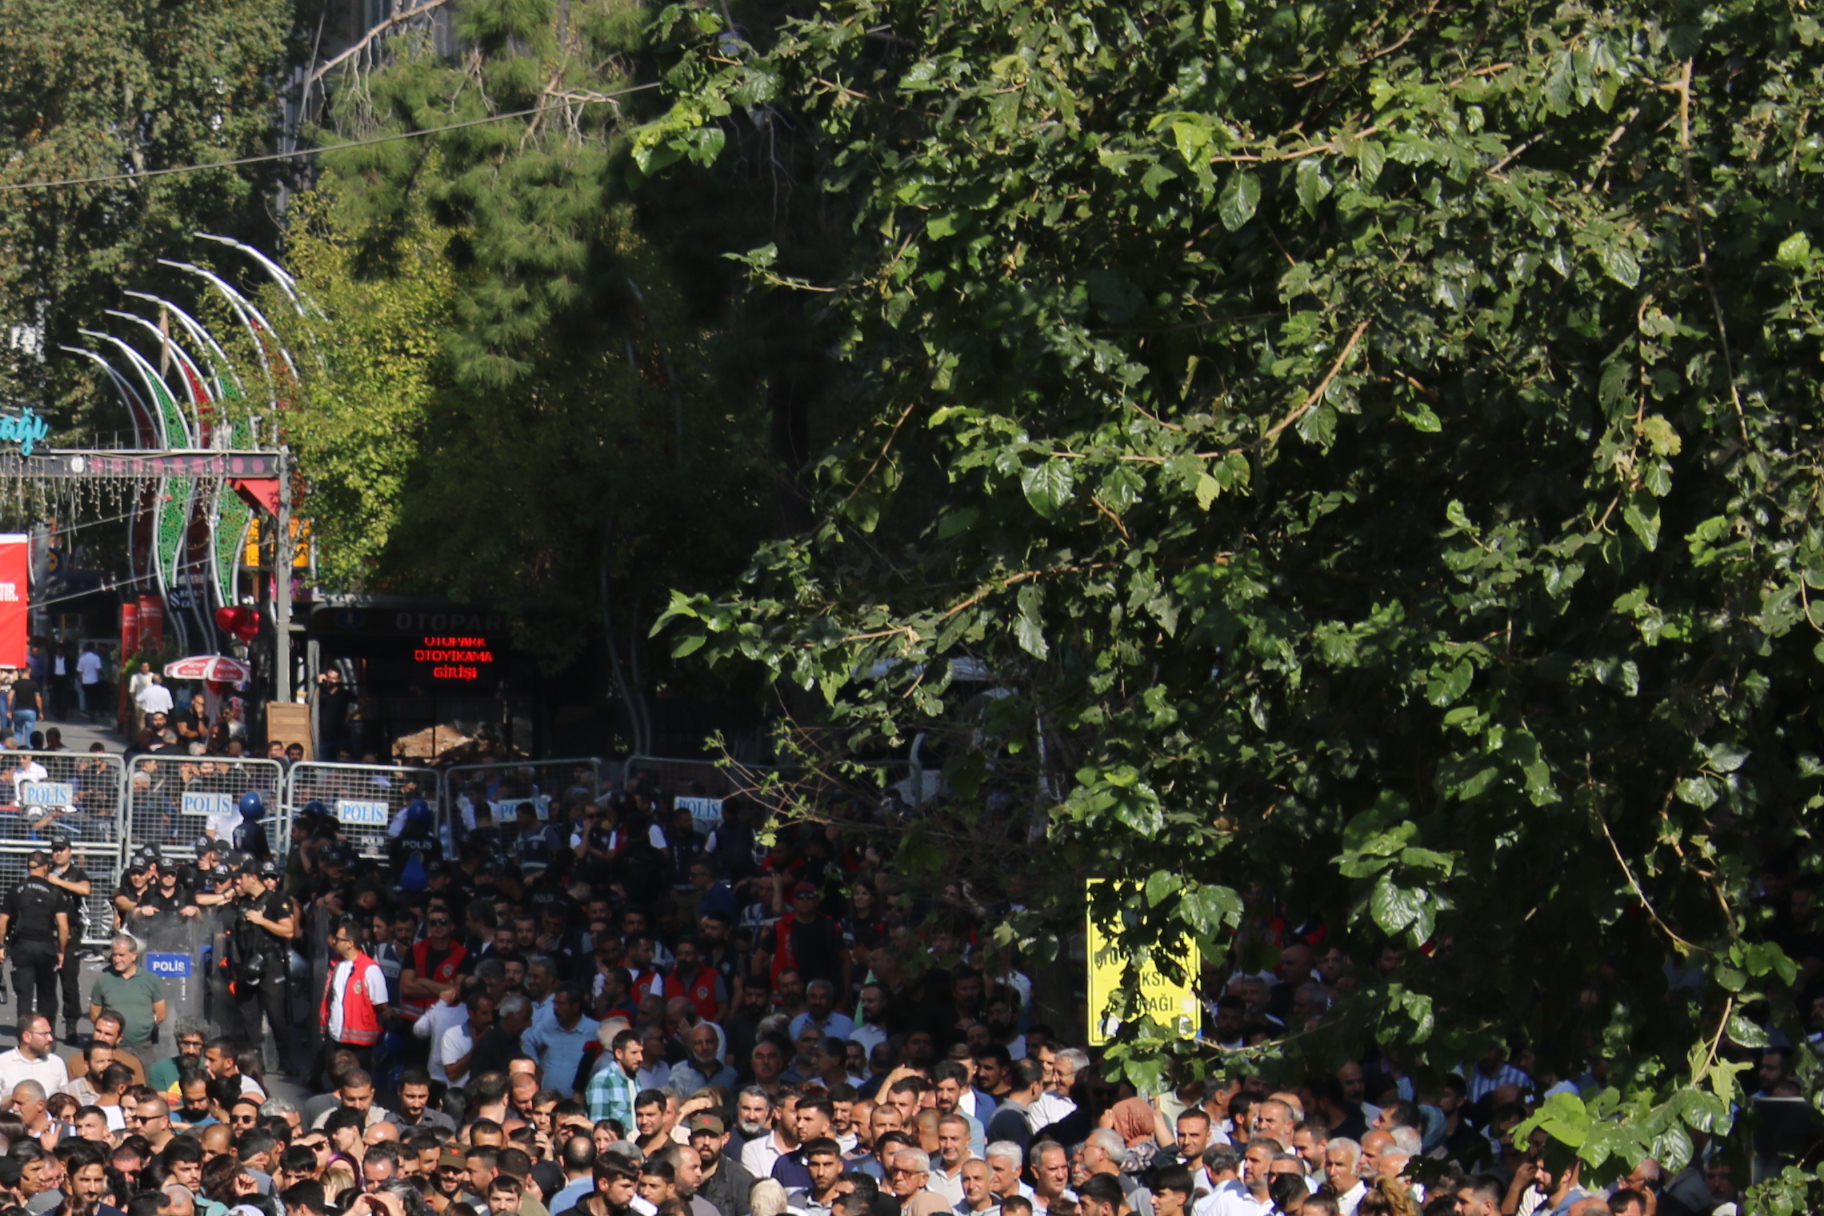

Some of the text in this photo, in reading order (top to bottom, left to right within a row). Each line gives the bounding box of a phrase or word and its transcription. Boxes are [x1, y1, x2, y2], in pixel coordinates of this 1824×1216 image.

[396, 612, 512, 632] OTOPAR
[27, 785, 68, 804] POLİS
[184, 793, 231, 813] POLİS
[342, 803, 384, 824] POLİS
[152, 958, 185, 974] POLİS
